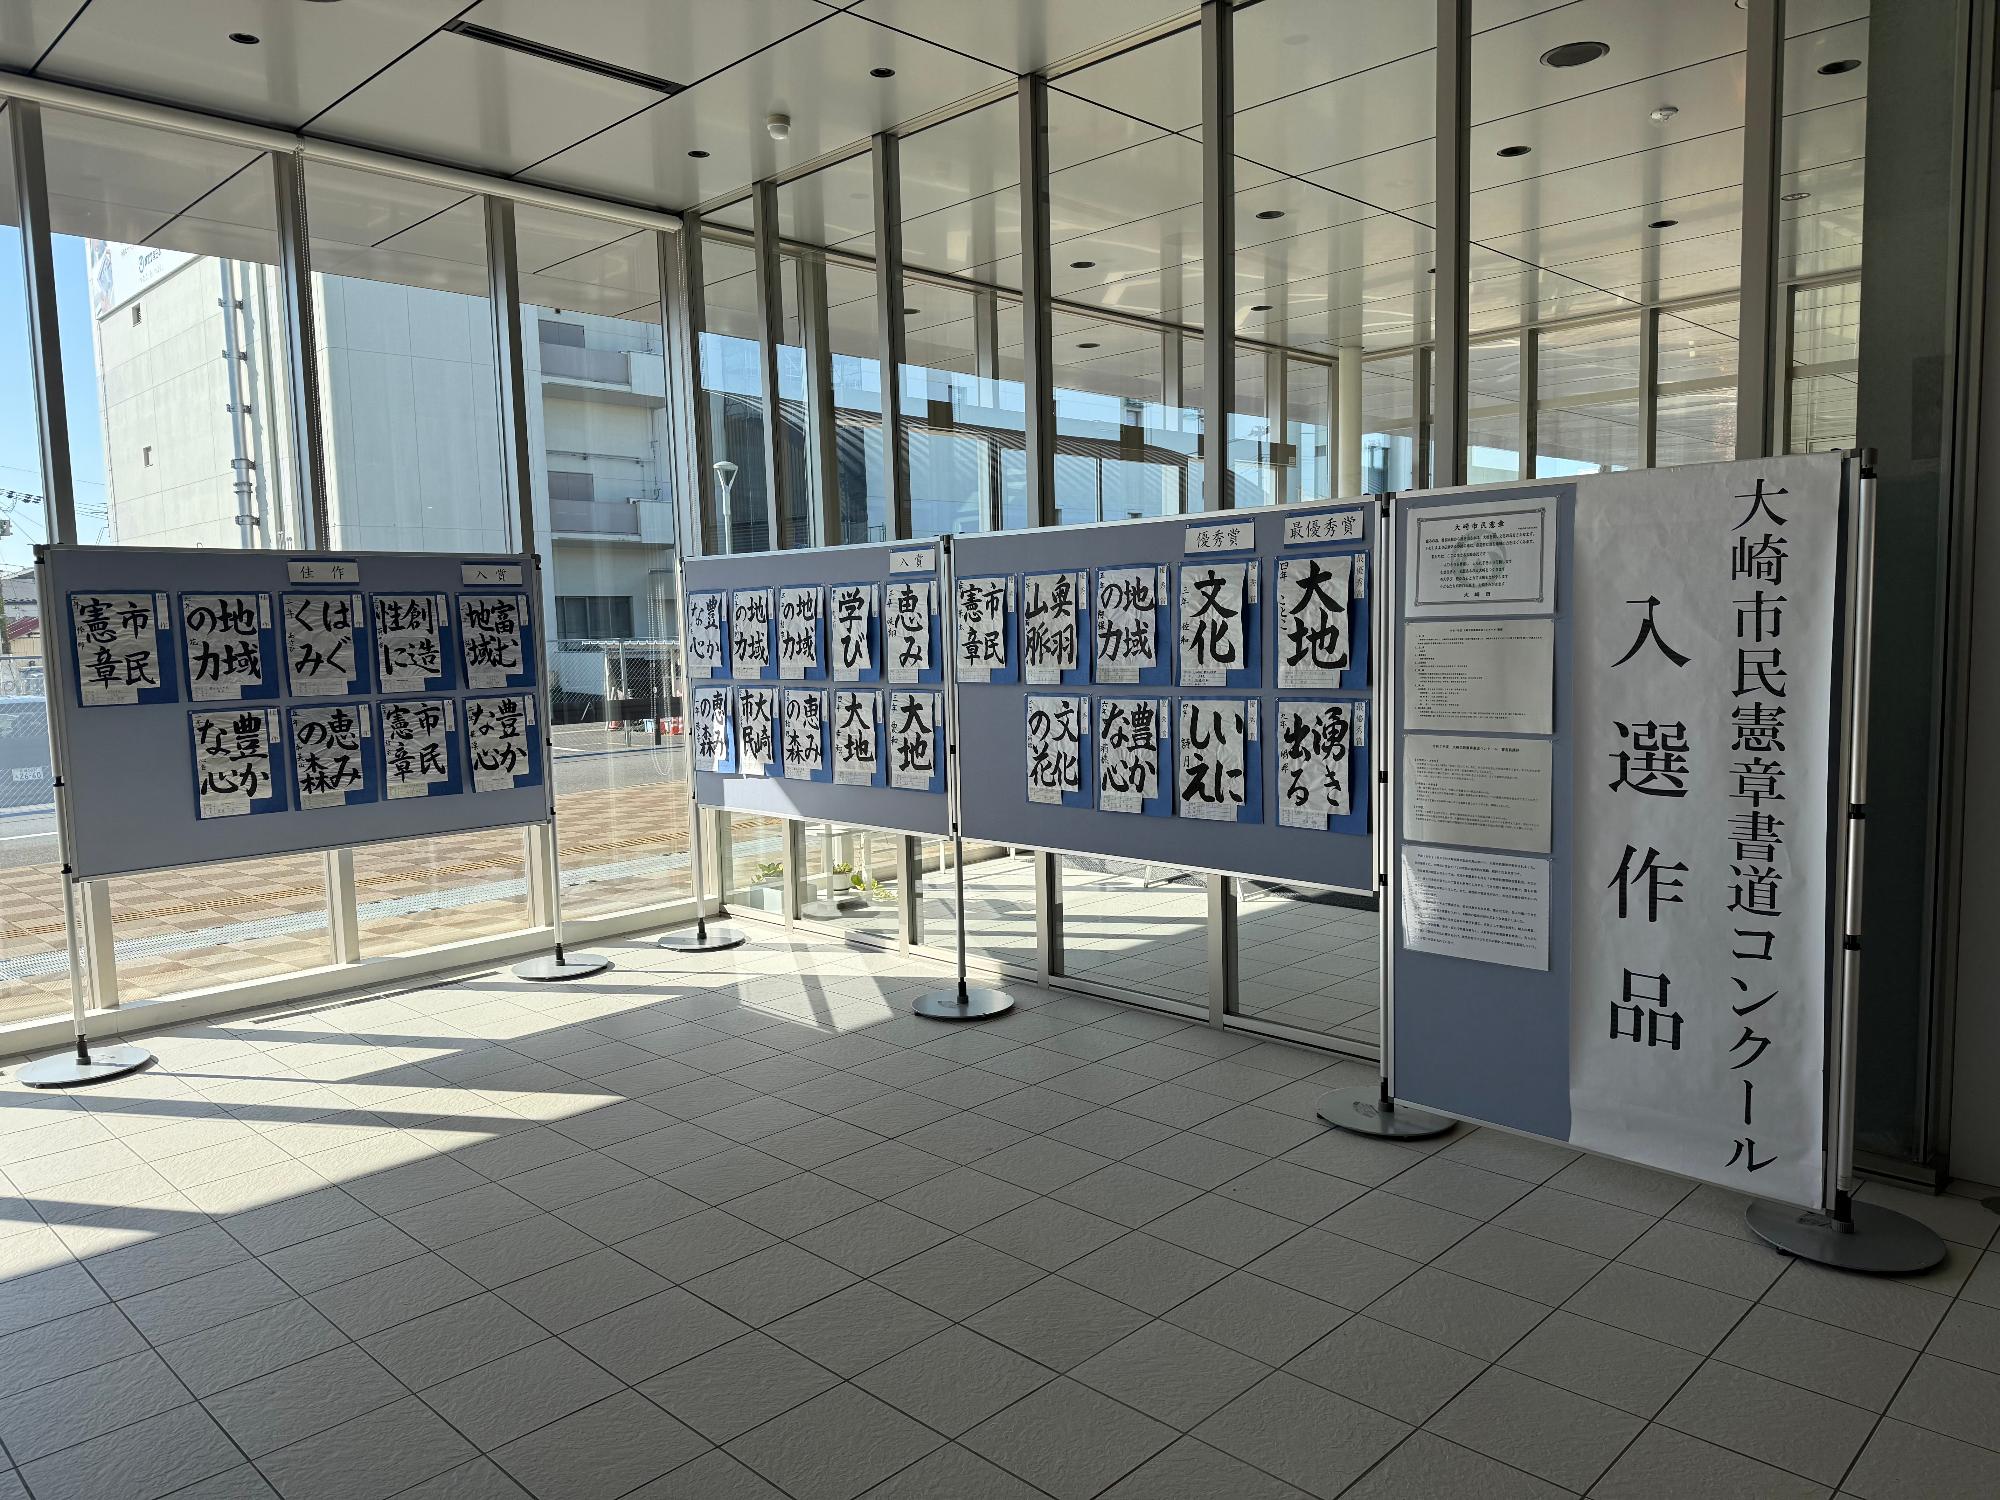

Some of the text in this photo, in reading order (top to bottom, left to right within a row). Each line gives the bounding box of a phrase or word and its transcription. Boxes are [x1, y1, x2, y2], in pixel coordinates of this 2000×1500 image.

[900, 553, 923, 567] 入賞
[1197, 527, 1241, 549] 優秀賞
[1290, 515, 1356, 540] 最優秀賞
[300, 566, 345, 580] 佳作
[476, 568, 507, 582] 入賞
[80, 598, 122, 689] 憲章
[116, 601, 156, 685] 市民
[187, 606, 220, 681] の力
[217, 599, 261, 680] 地域
[295, 600, 324, 676] くみ
[323, 600, 351, 674] はぐ
[379, 600, 408, 675] 性に
[404, 598, 440, 673] 創造
[838, 587, 864, 668] 学び
[895, 584, 923, 667] 恵み
[960, 584, 983, 666] 憲章
[982, 582, 1004, 664] 市民
[1098, 584, 1122, 661] の力
[1123, 576, 1154, 660] 地域
[1188, 569, 1238, 665] 文化
[1286, 560, 1347, 669] 大地
[197, 719, 238, 795] な心
[230, 712, 269, 797] 豊か
[298, 721, 335, 794] の森
[327, 709, 361, 789] 恵み
[386, 704, 416, 783] 憲章
[413, 703, 446, 775] 市民
[472, 702, 499, 771] な心
[496, 698, 527, 773] 豊か
[840, 692, 874, 762] 大地
[897, 694, 932, 771] 大地
[1028, 711, 1056, 787] の花
[1051, 700, 1078, 786] 文化
[1102, 702, 1130, 792] な心
[1127, 701, 1156, 793] 豊か
[1312, 707, 1348, 807] 湧き
[1608, 595, 1692, 1050] 入選作品
[1725, 479, 1787, 1172] 大崎市民憲章書道コンクール
